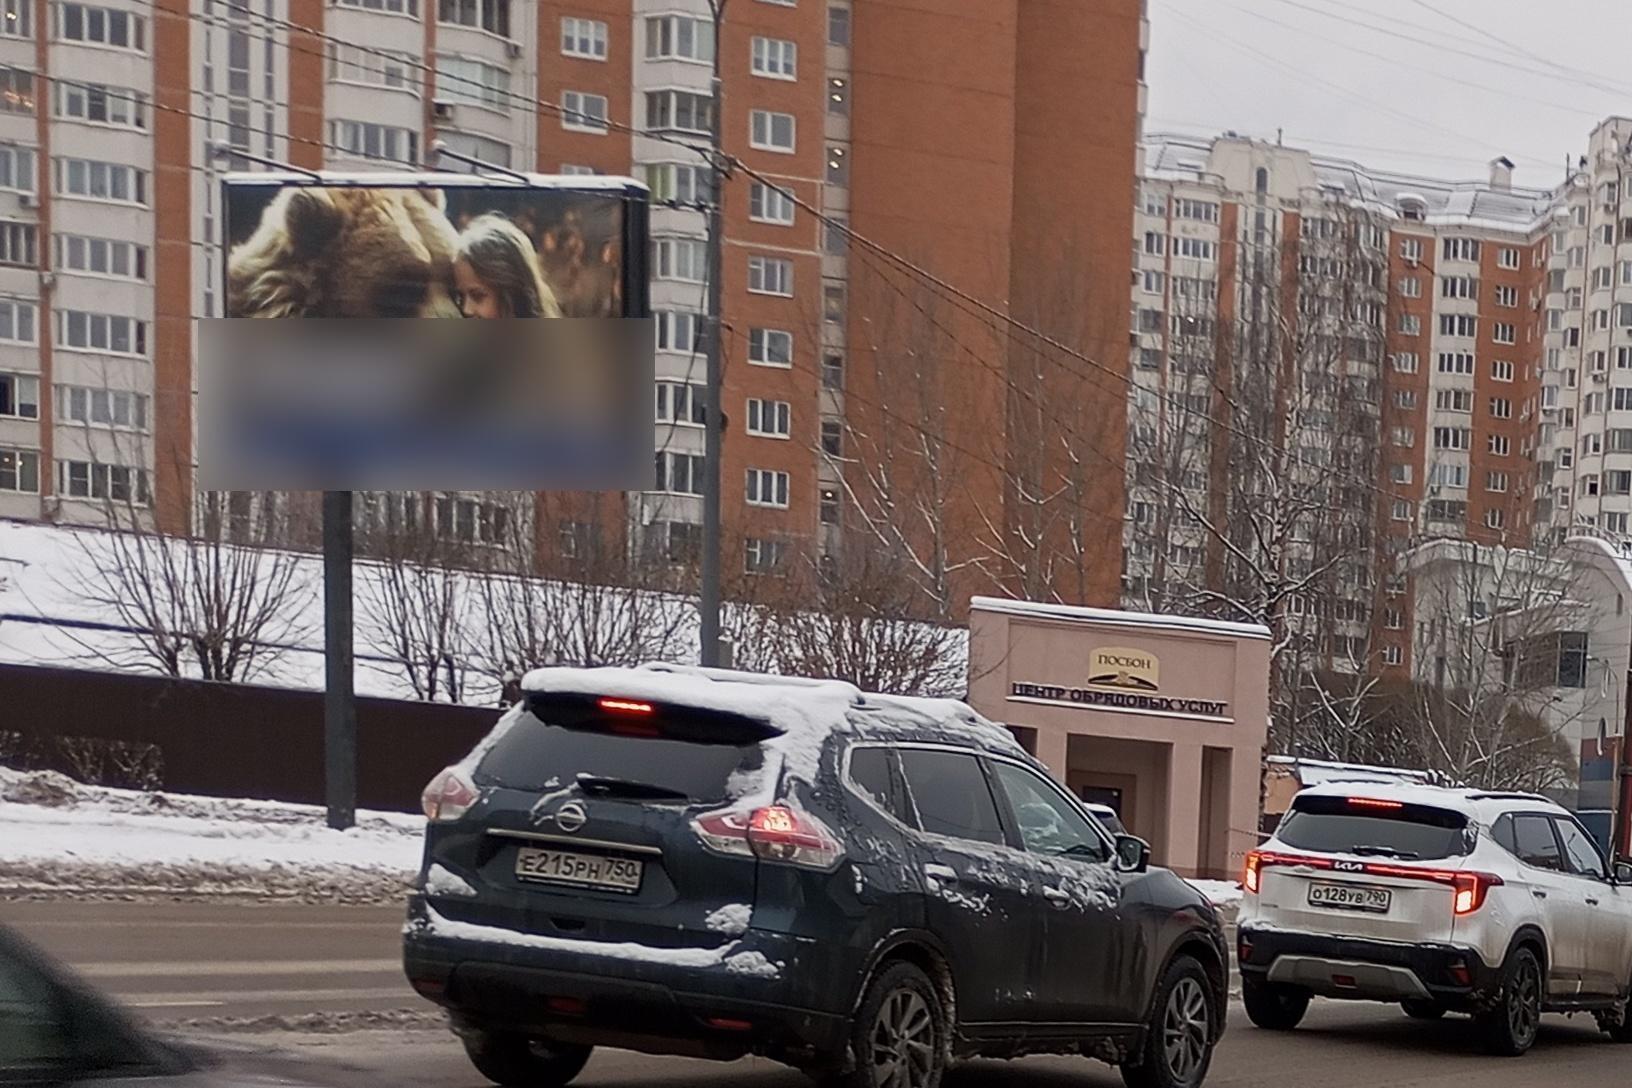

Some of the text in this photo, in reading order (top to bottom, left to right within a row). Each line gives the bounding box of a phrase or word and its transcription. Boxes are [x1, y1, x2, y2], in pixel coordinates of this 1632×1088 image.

[1012, 683, 1228, 714] ЦЕНТР ОБРЯДОВЫХ УСЛУГ
